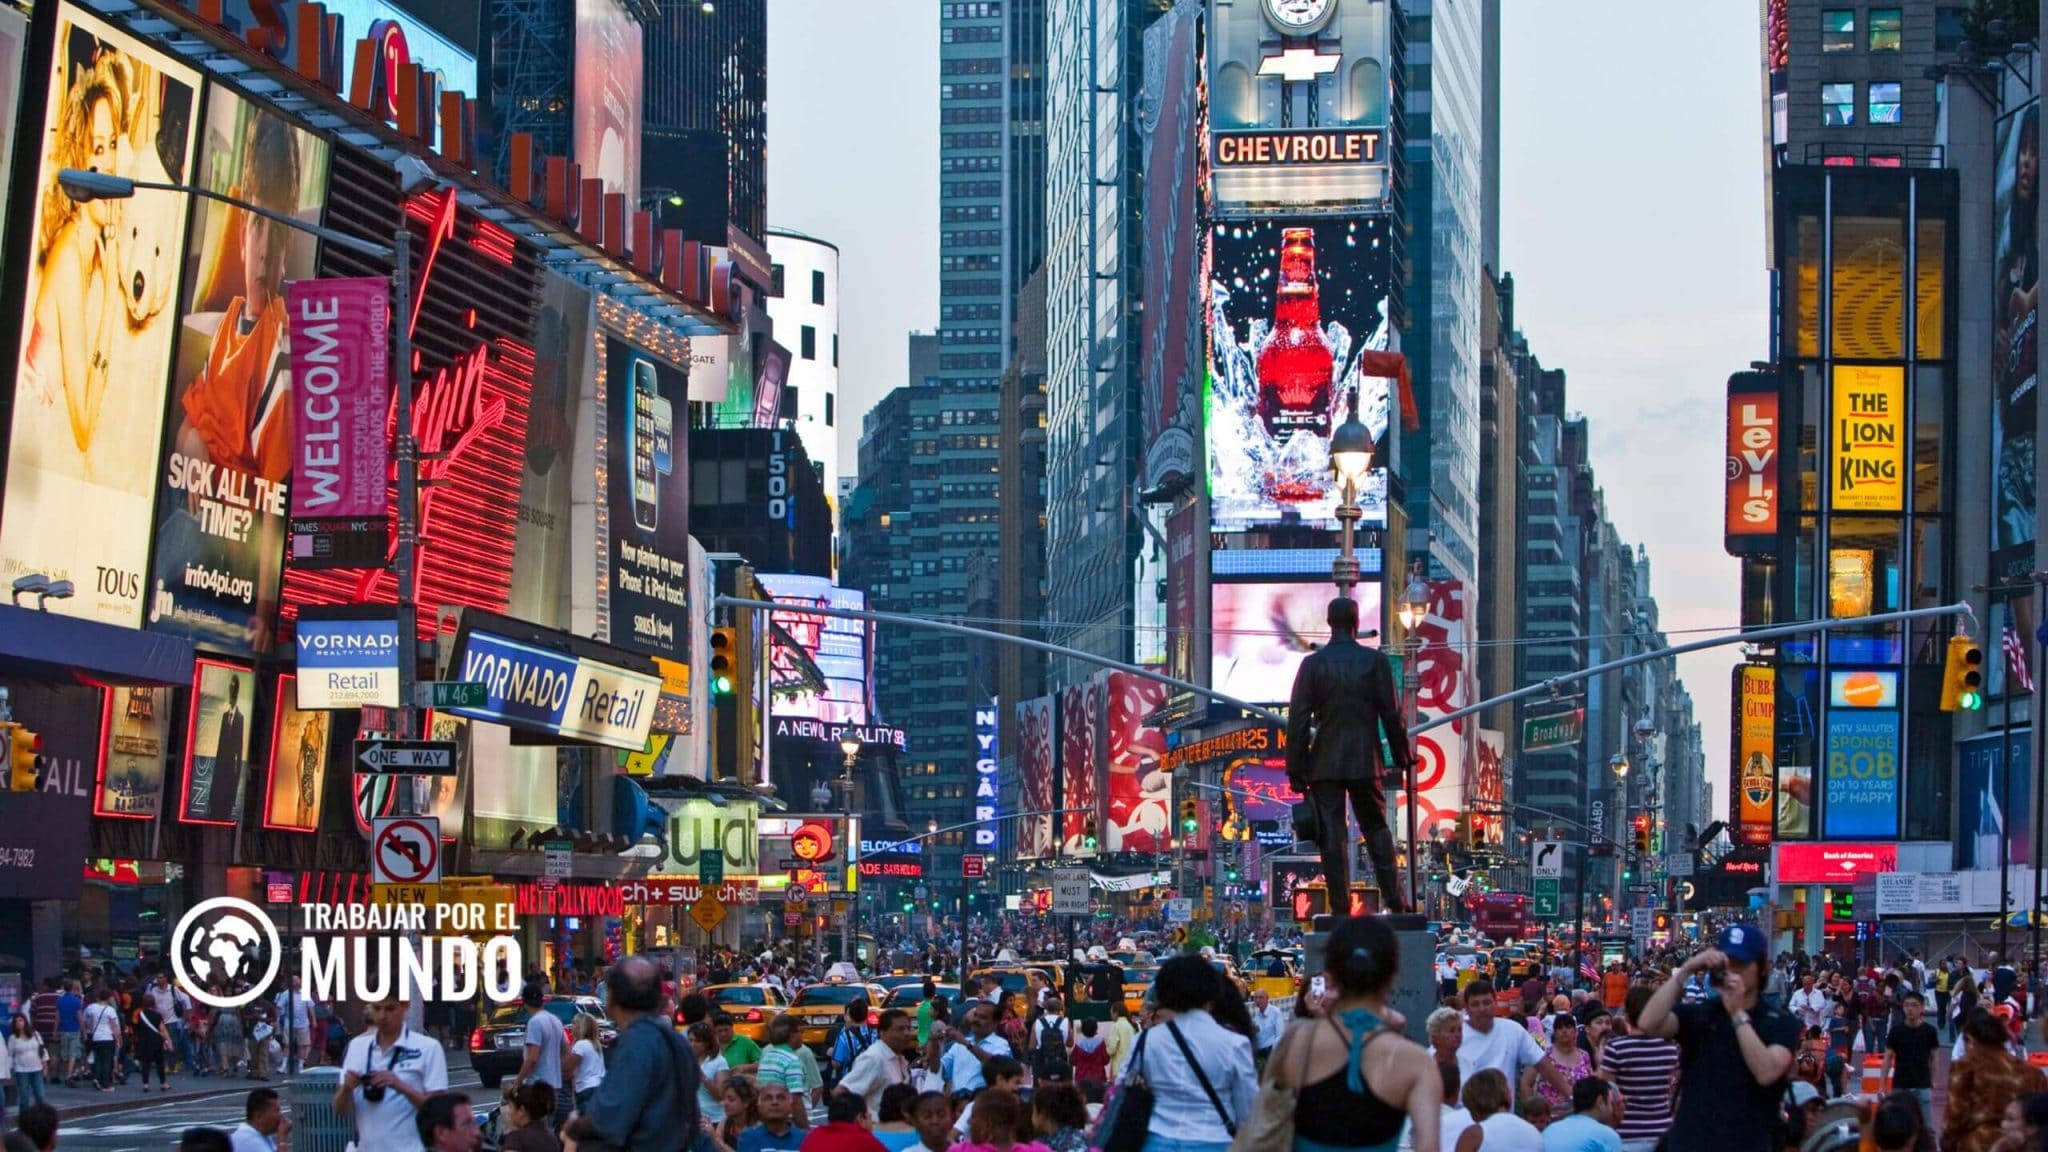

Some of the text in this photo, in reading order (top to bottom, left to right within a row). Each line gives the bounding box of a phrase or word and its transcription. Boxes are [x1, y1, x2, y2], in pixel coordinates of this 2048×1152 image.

[1219, 134, 1378, 162] CHEVROLET
[302, 297, 340, 508] WELCOME
[1848, 393, 1888, 412] THE
[1841, 419, 1895, 453] LION
[168, 452, 287, 516] SICK ALL THE
[768, 432, 786, 519] 1500
[1840, 457, 1896, 491] KING
[200, 499, 252, 543] TIME?
[621, 539, 685, 579] Now playing on your
[96, 565, 139, 600] TOUS
[184, 562, 253, 603] info4pi.org
[651, 576, 665, 600] iPod
[329, 672, 379, 690] Retail
[465, 650, 645, 730] VORNADO Retail
[437, 684, 484, 705] W 46 ST
[1533, 722, 1576, 742] Broadway
[1831, 724, 1895, 733] MTV SALUTES
[1831, 736, 1894, 749] SPONGE
[369, 751, 444, 764] ONE WAY
[1829, 751, 1895, 778] BOB
[1970, 744, 2021, 769] TIPTP
[1828, 780, 1894, 790] ON 10 YEARS
[1828, 791, 1894, 803] OF HAPPY
[386, 887, 426, 904] NEW
[1061, 886, 1081, 896] MUST
[1070, 901, 1088, 909] RIGHT
